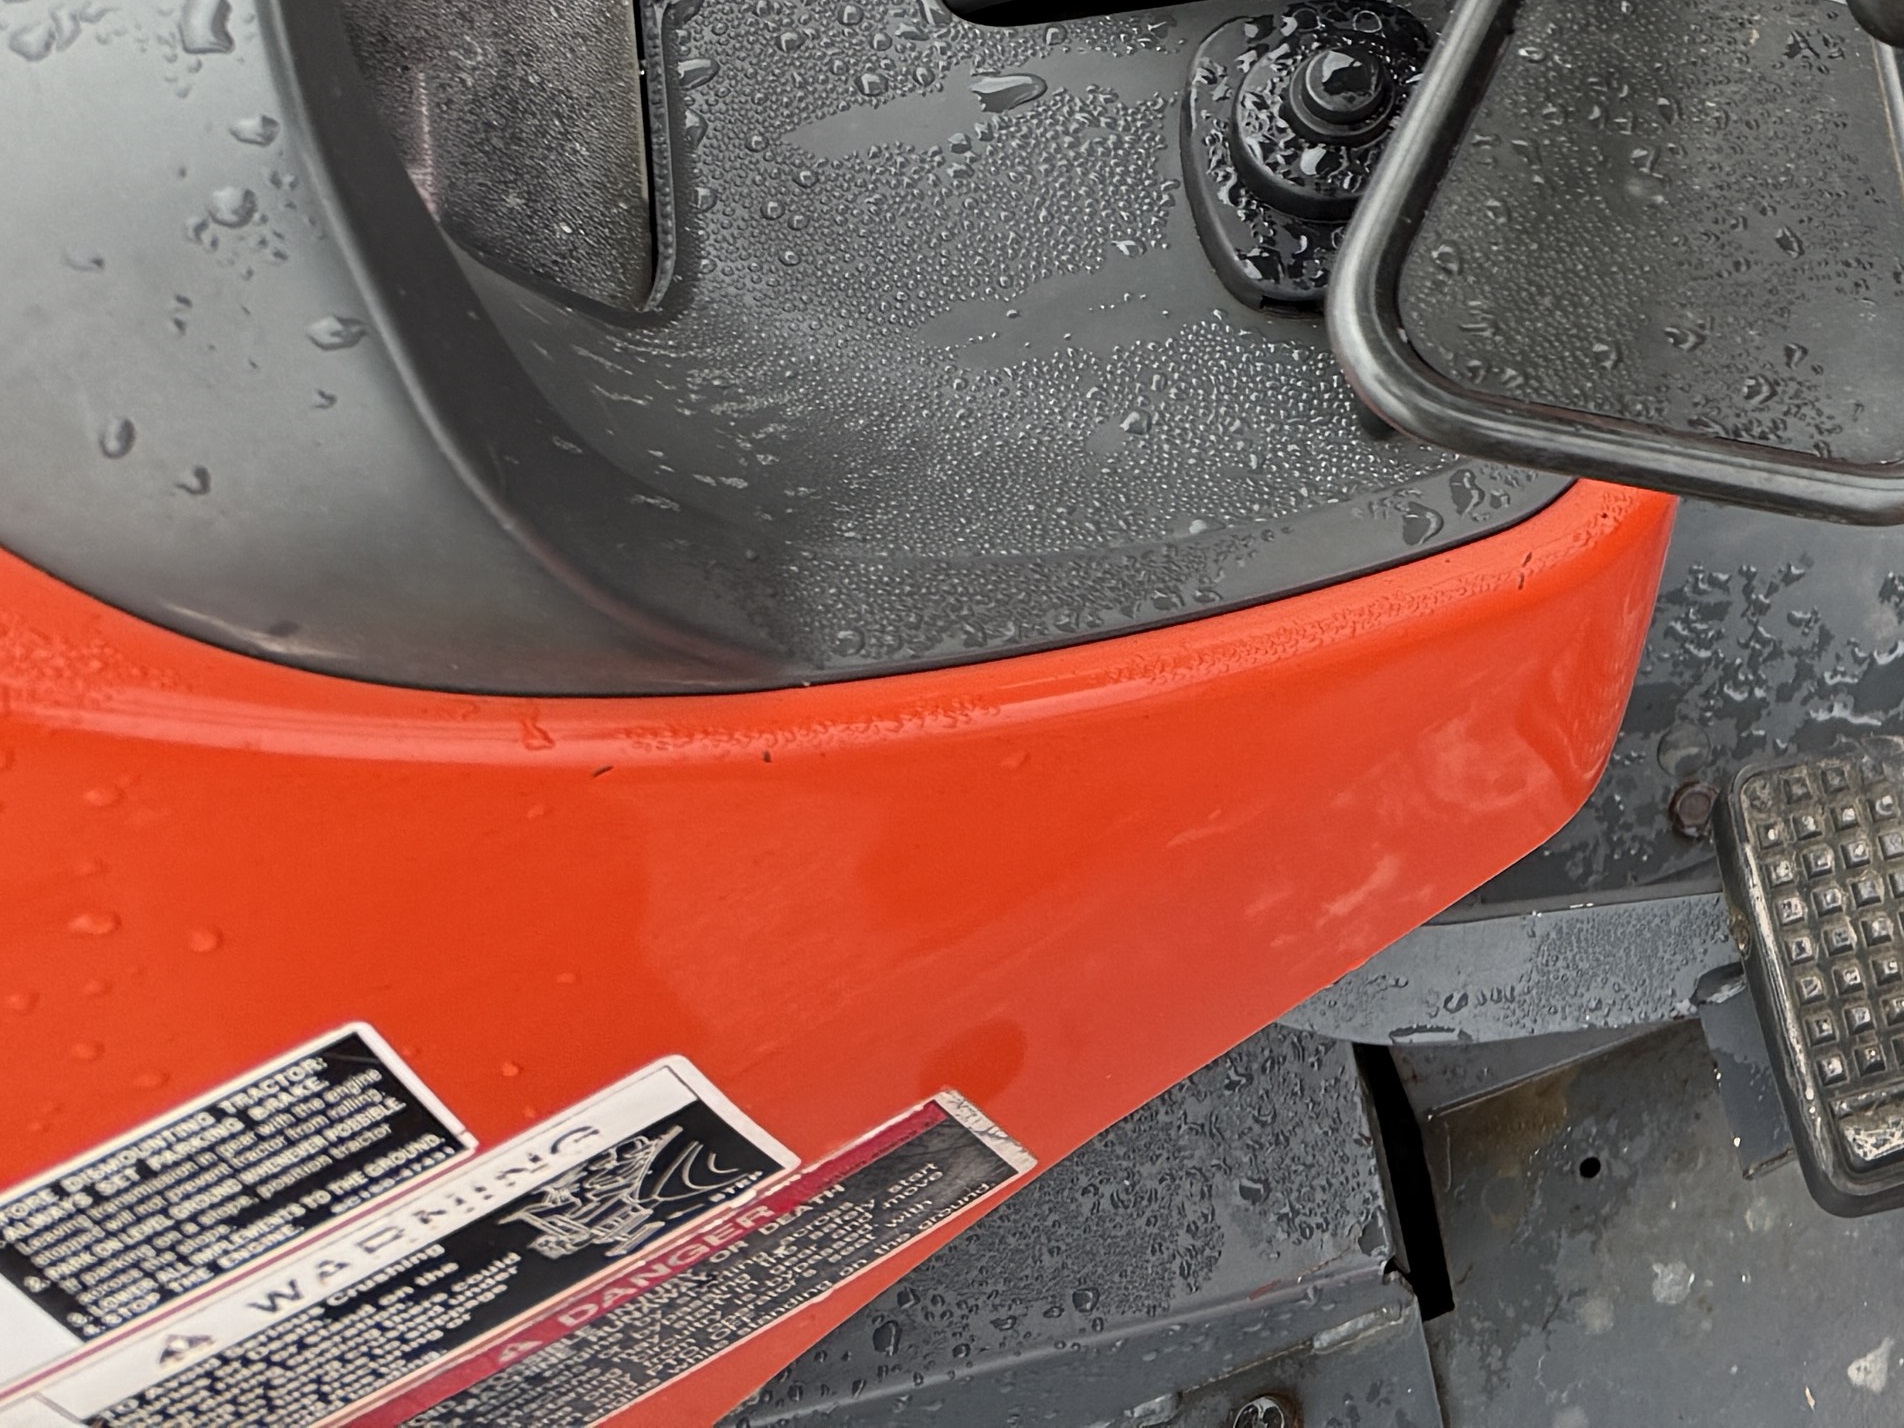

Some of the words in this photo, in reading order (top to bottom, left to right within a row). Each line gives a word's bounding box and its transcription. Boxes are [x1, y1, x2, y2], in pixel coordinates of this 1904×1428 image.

[216, 1054, 329, 1115] TRACTOR:
[298, 1187, 333, 1211] TO
[325, 1168, 370, 1197] THE
[361, 1130, 446, 1178] GROUND.
[885, 1160, 938, 1195] start
[708, 1238, 750, 1265] OR
[758, 1182, 846, 1236] DEATH
[324, 1241, 448, 1309] Crushing
[559, 1201, 776, 1329] DANGER
